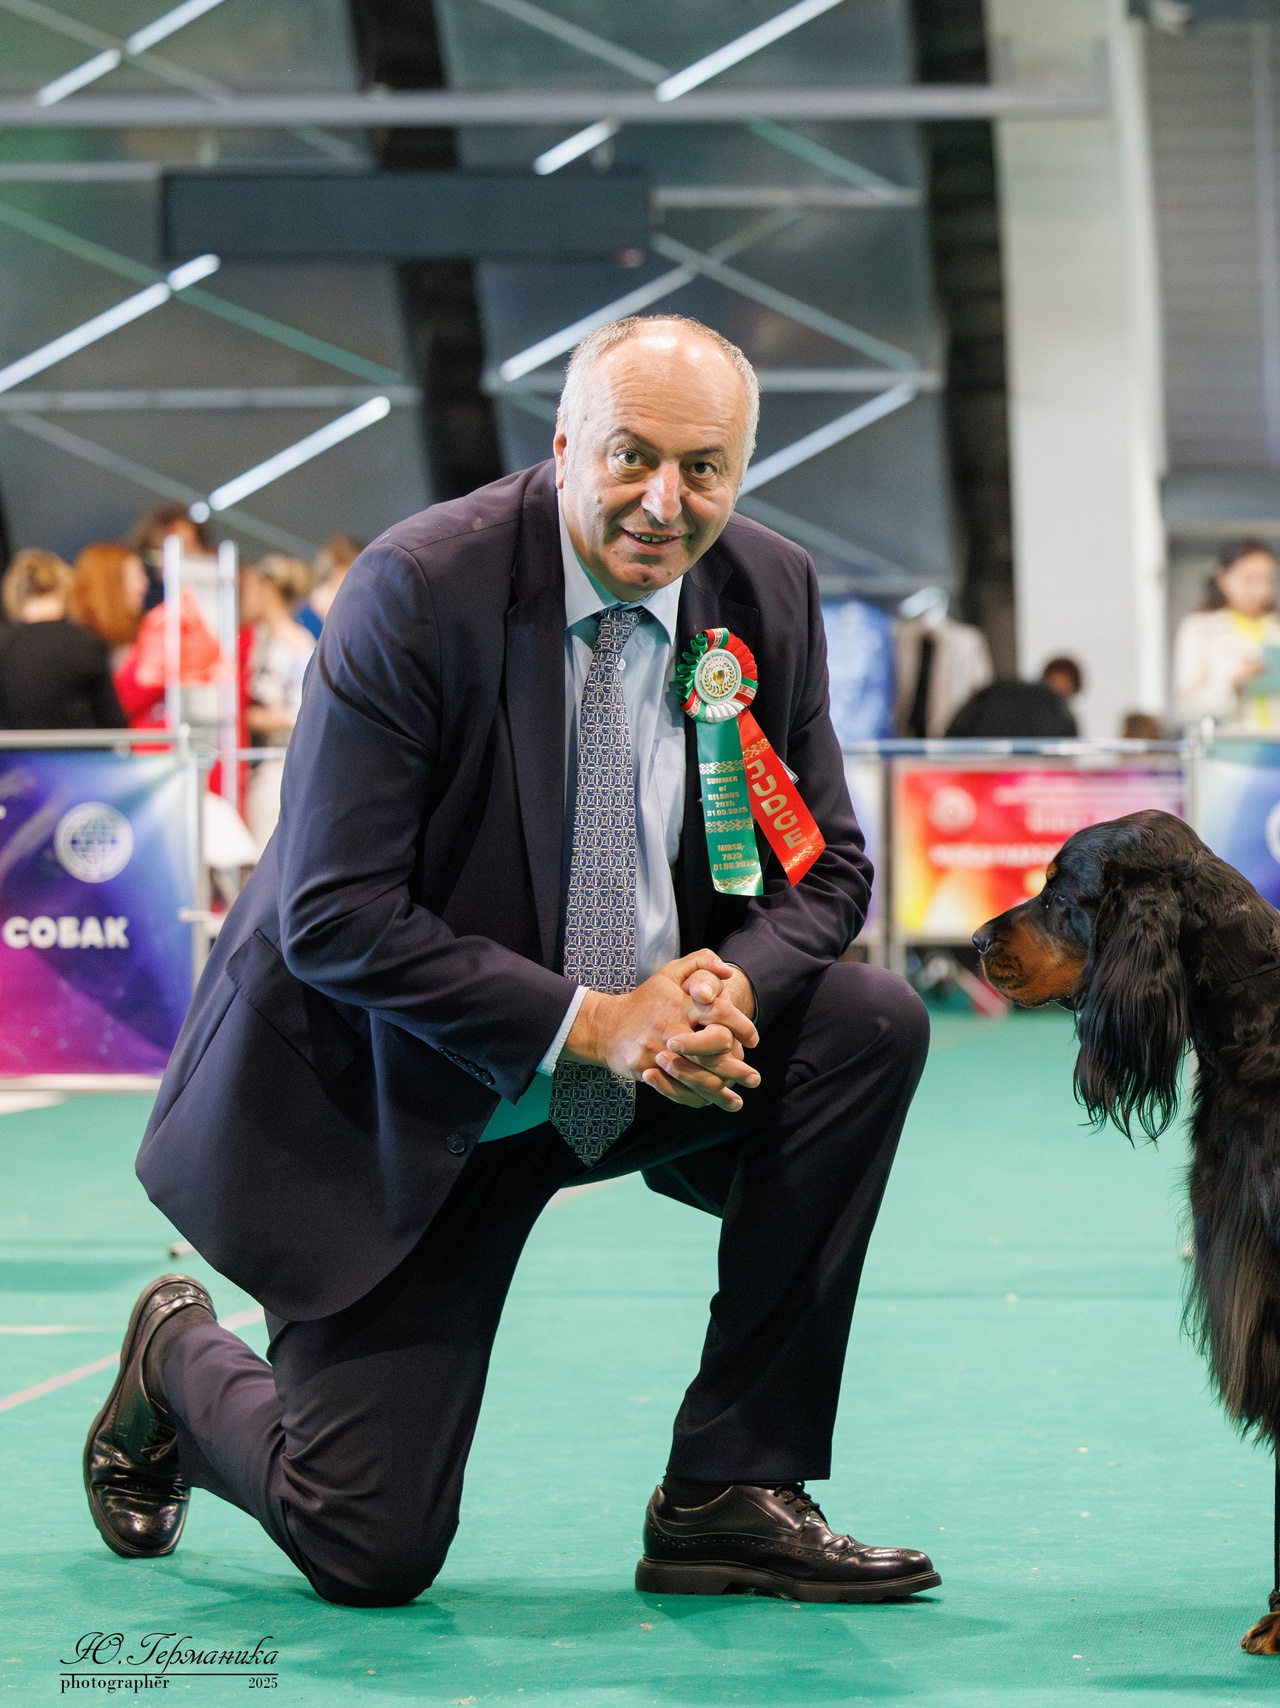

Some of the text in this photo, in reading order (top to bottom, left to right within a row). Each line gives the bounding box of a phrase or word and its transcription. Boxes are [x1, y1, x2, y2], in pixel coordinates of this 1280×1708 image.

[706, 775, 738, 785] SUMMER
[707, 791, 740, 801] BELARUS
[715, 800, 735, 808] 2025
[746, 758, 807, 849] JUDGE
[722, 852, 742, 861] 2025
[2, 915, 130, 949] СОБАК
